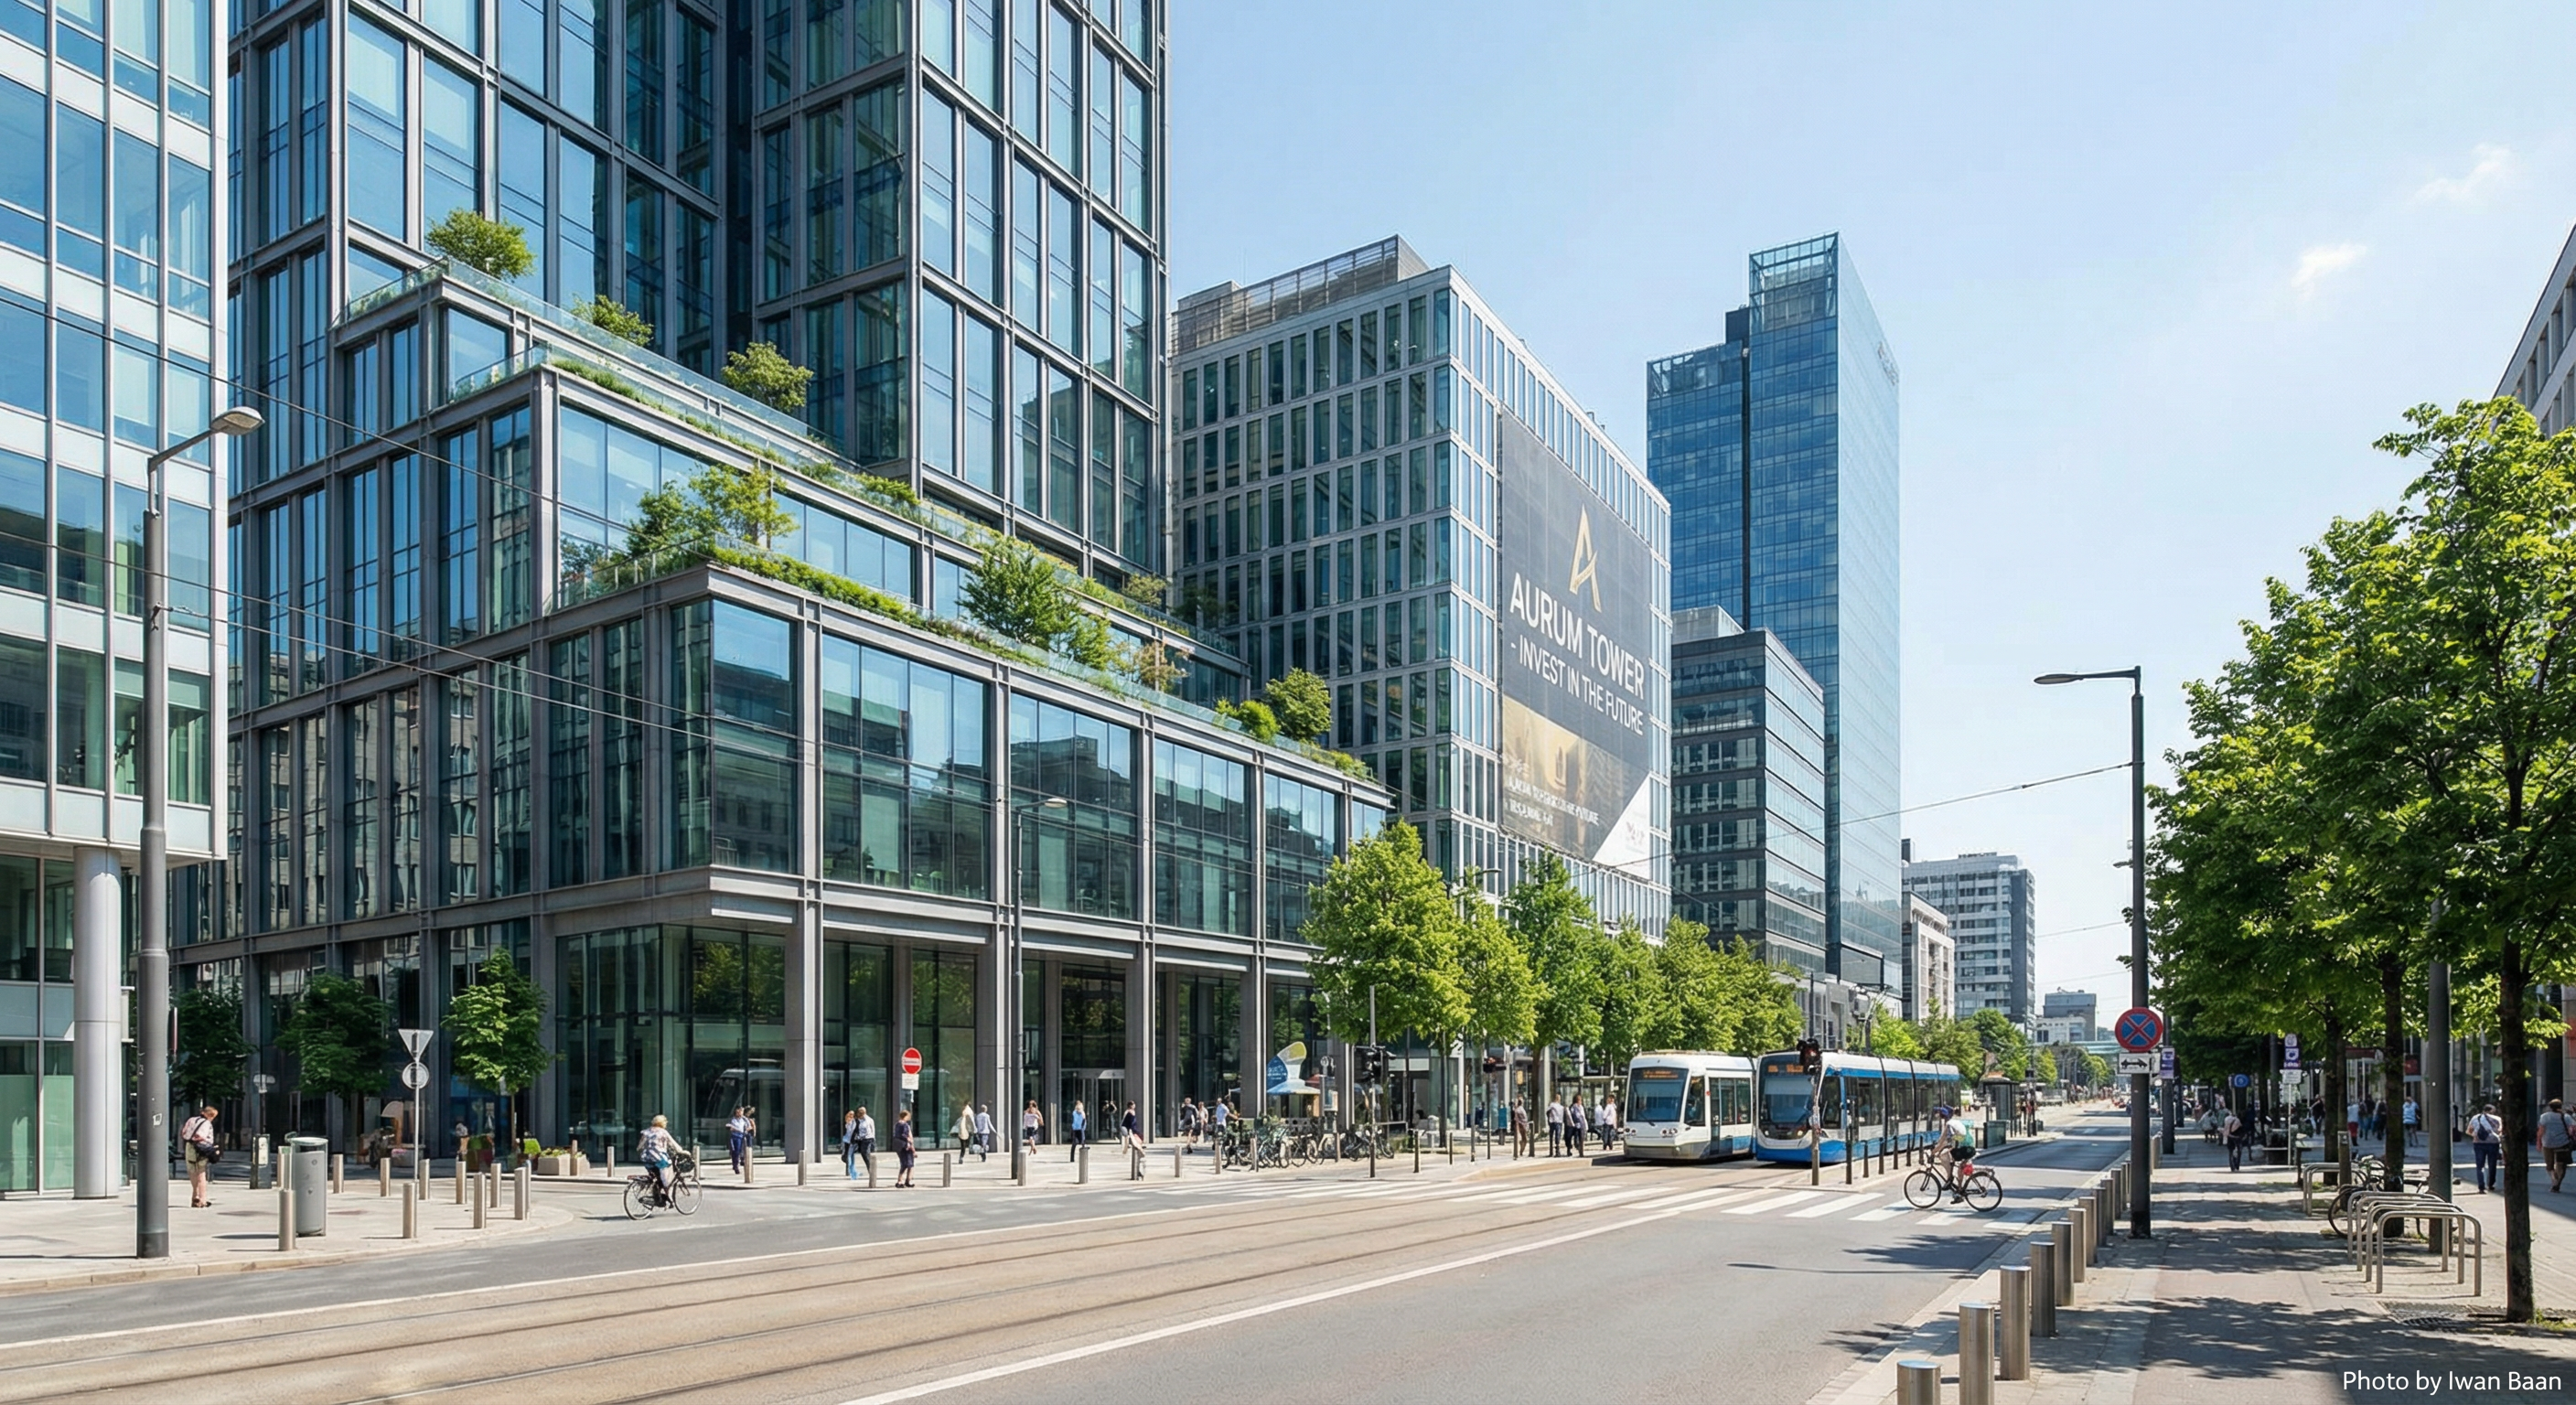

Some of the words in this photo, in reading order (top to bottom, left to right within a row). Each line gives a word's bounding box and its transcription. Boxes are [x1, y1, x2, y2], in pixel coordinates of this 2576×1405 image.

[1509, 572, 1583, 659] AURUM
[1587, 623, 1645, 700] TOWER
[1519, 634, 1566, 688] INVEST
[1567, 665, 1580, 698] IN
[1582, 673, 1605, 713] THE
[1605, 690, 1644, 736] FUTURE
